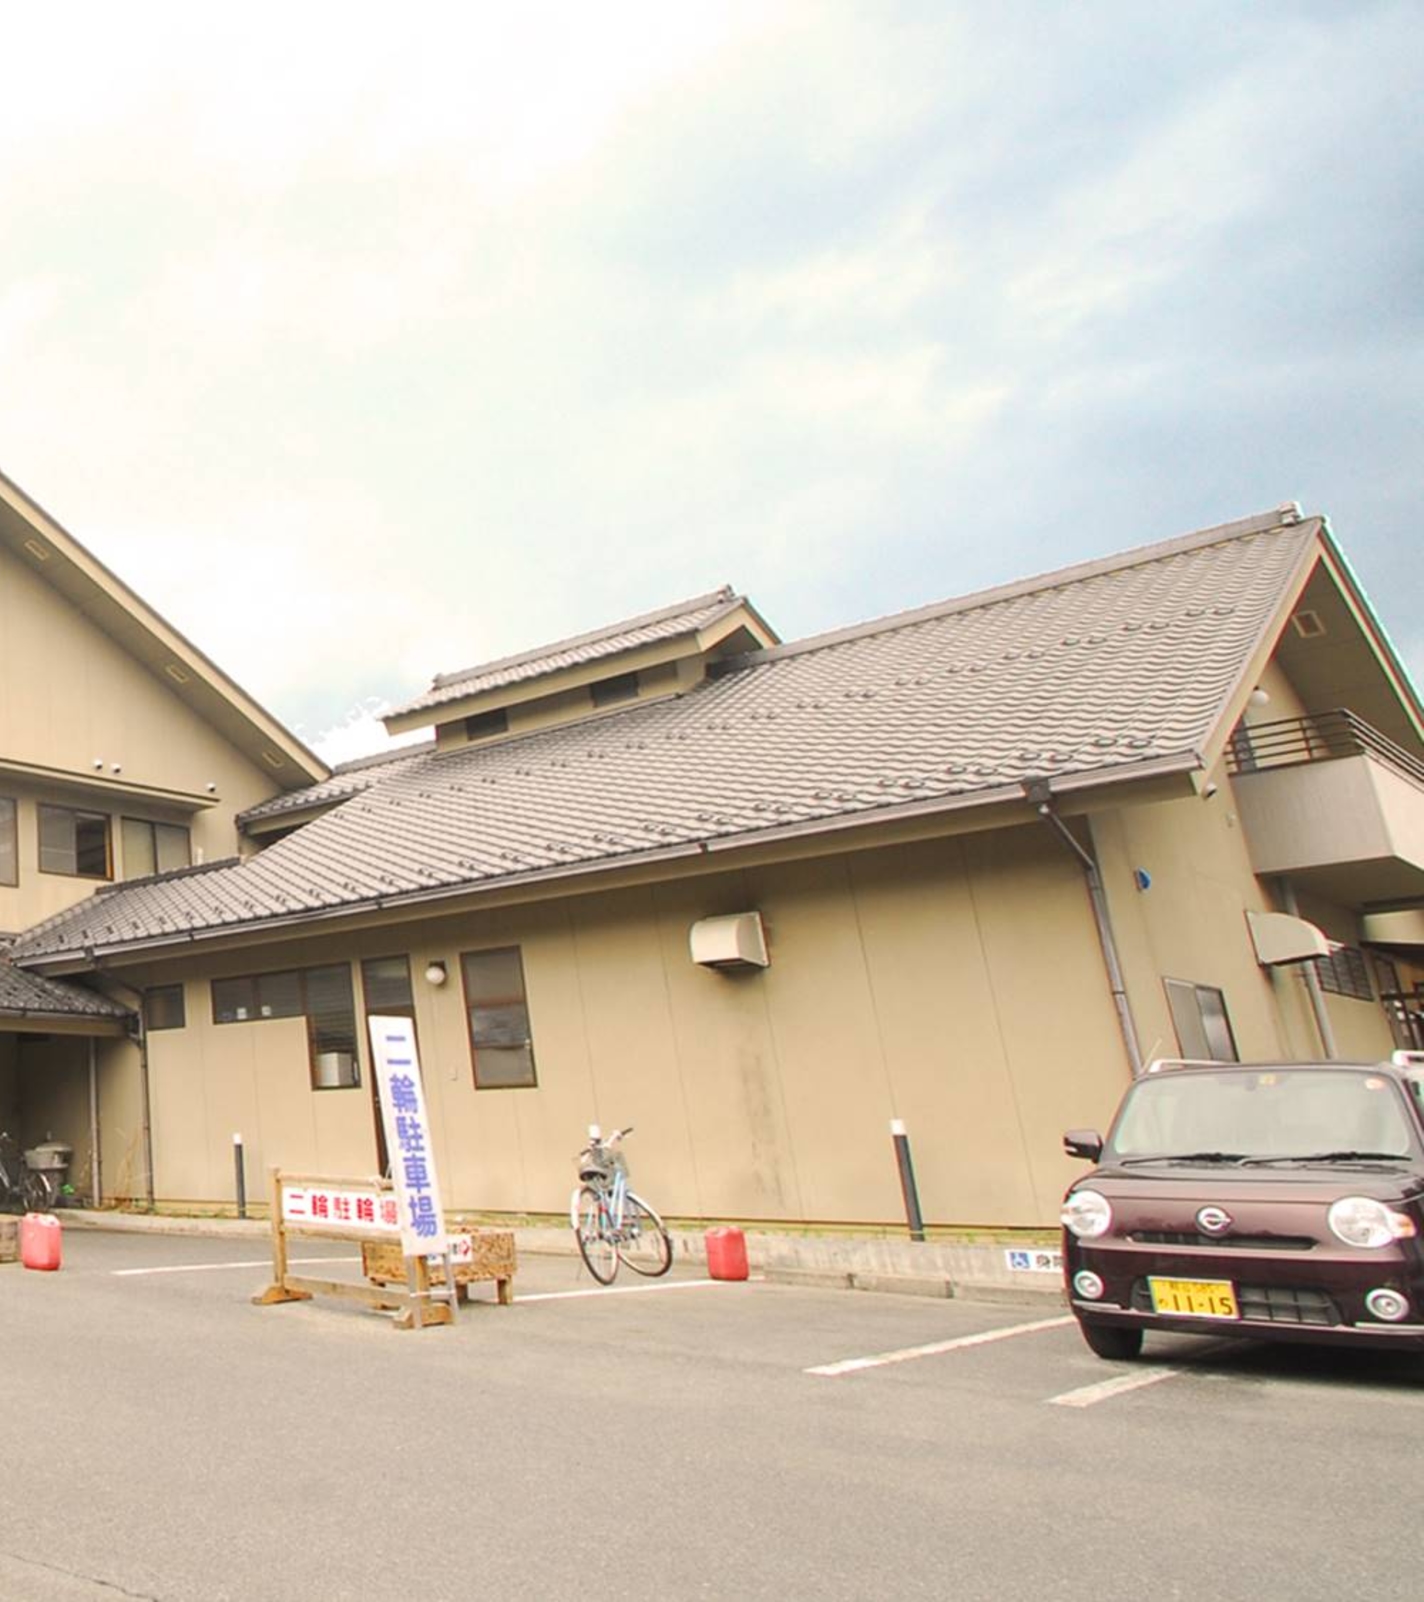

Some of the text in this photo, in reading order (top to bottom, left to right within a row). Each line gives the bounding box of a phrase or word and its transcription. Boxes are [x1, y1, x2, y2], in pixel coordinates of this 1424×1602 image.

[386, 1036, 438, 1239] 二輪駐車場
[289, 1194, 398, 1226] 二輪駐輪場
